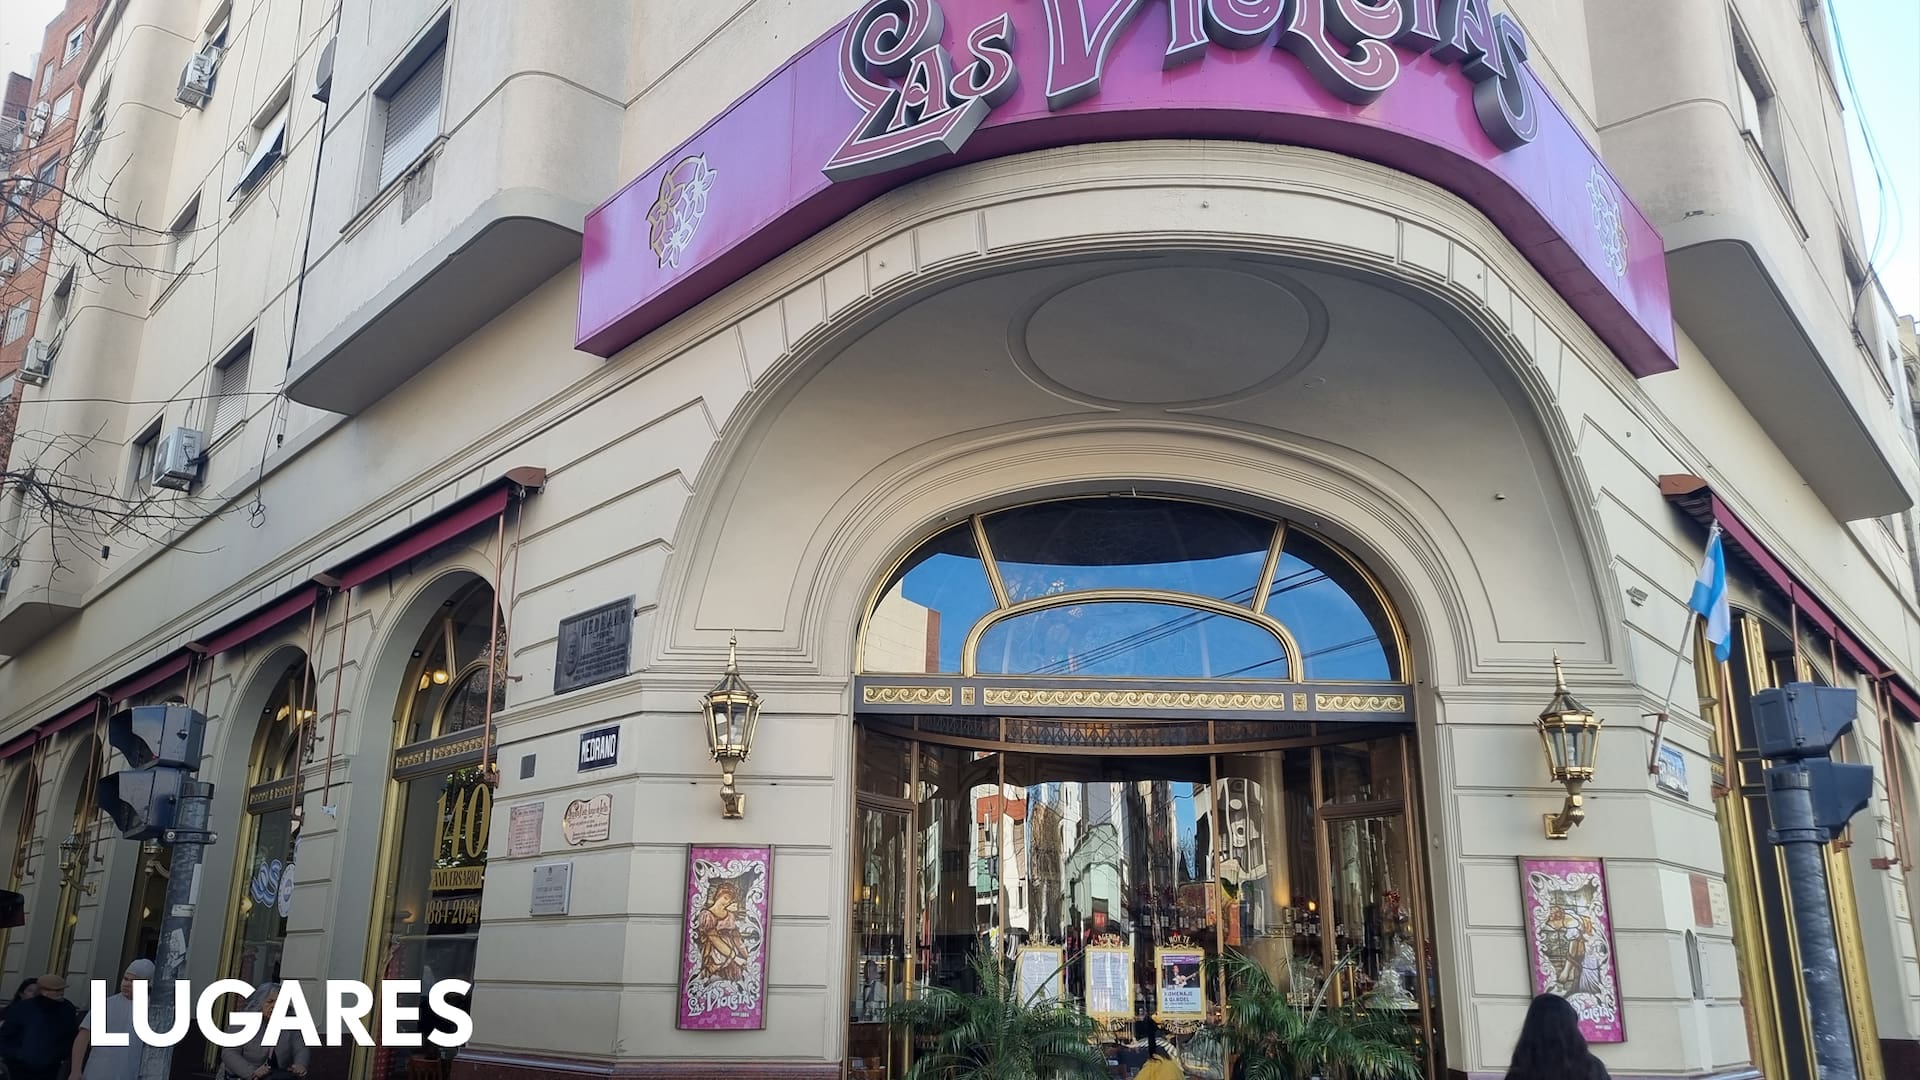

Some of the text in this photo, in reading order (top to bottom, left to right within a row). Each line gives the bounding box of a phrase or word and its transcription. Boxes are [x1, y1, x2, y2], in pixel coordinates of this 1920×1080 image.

[580, 733, 617, 763] MEDRANO
[433, 783, 492, 861] 140
[433, 869, 480, 888] ANIVERSARIO
